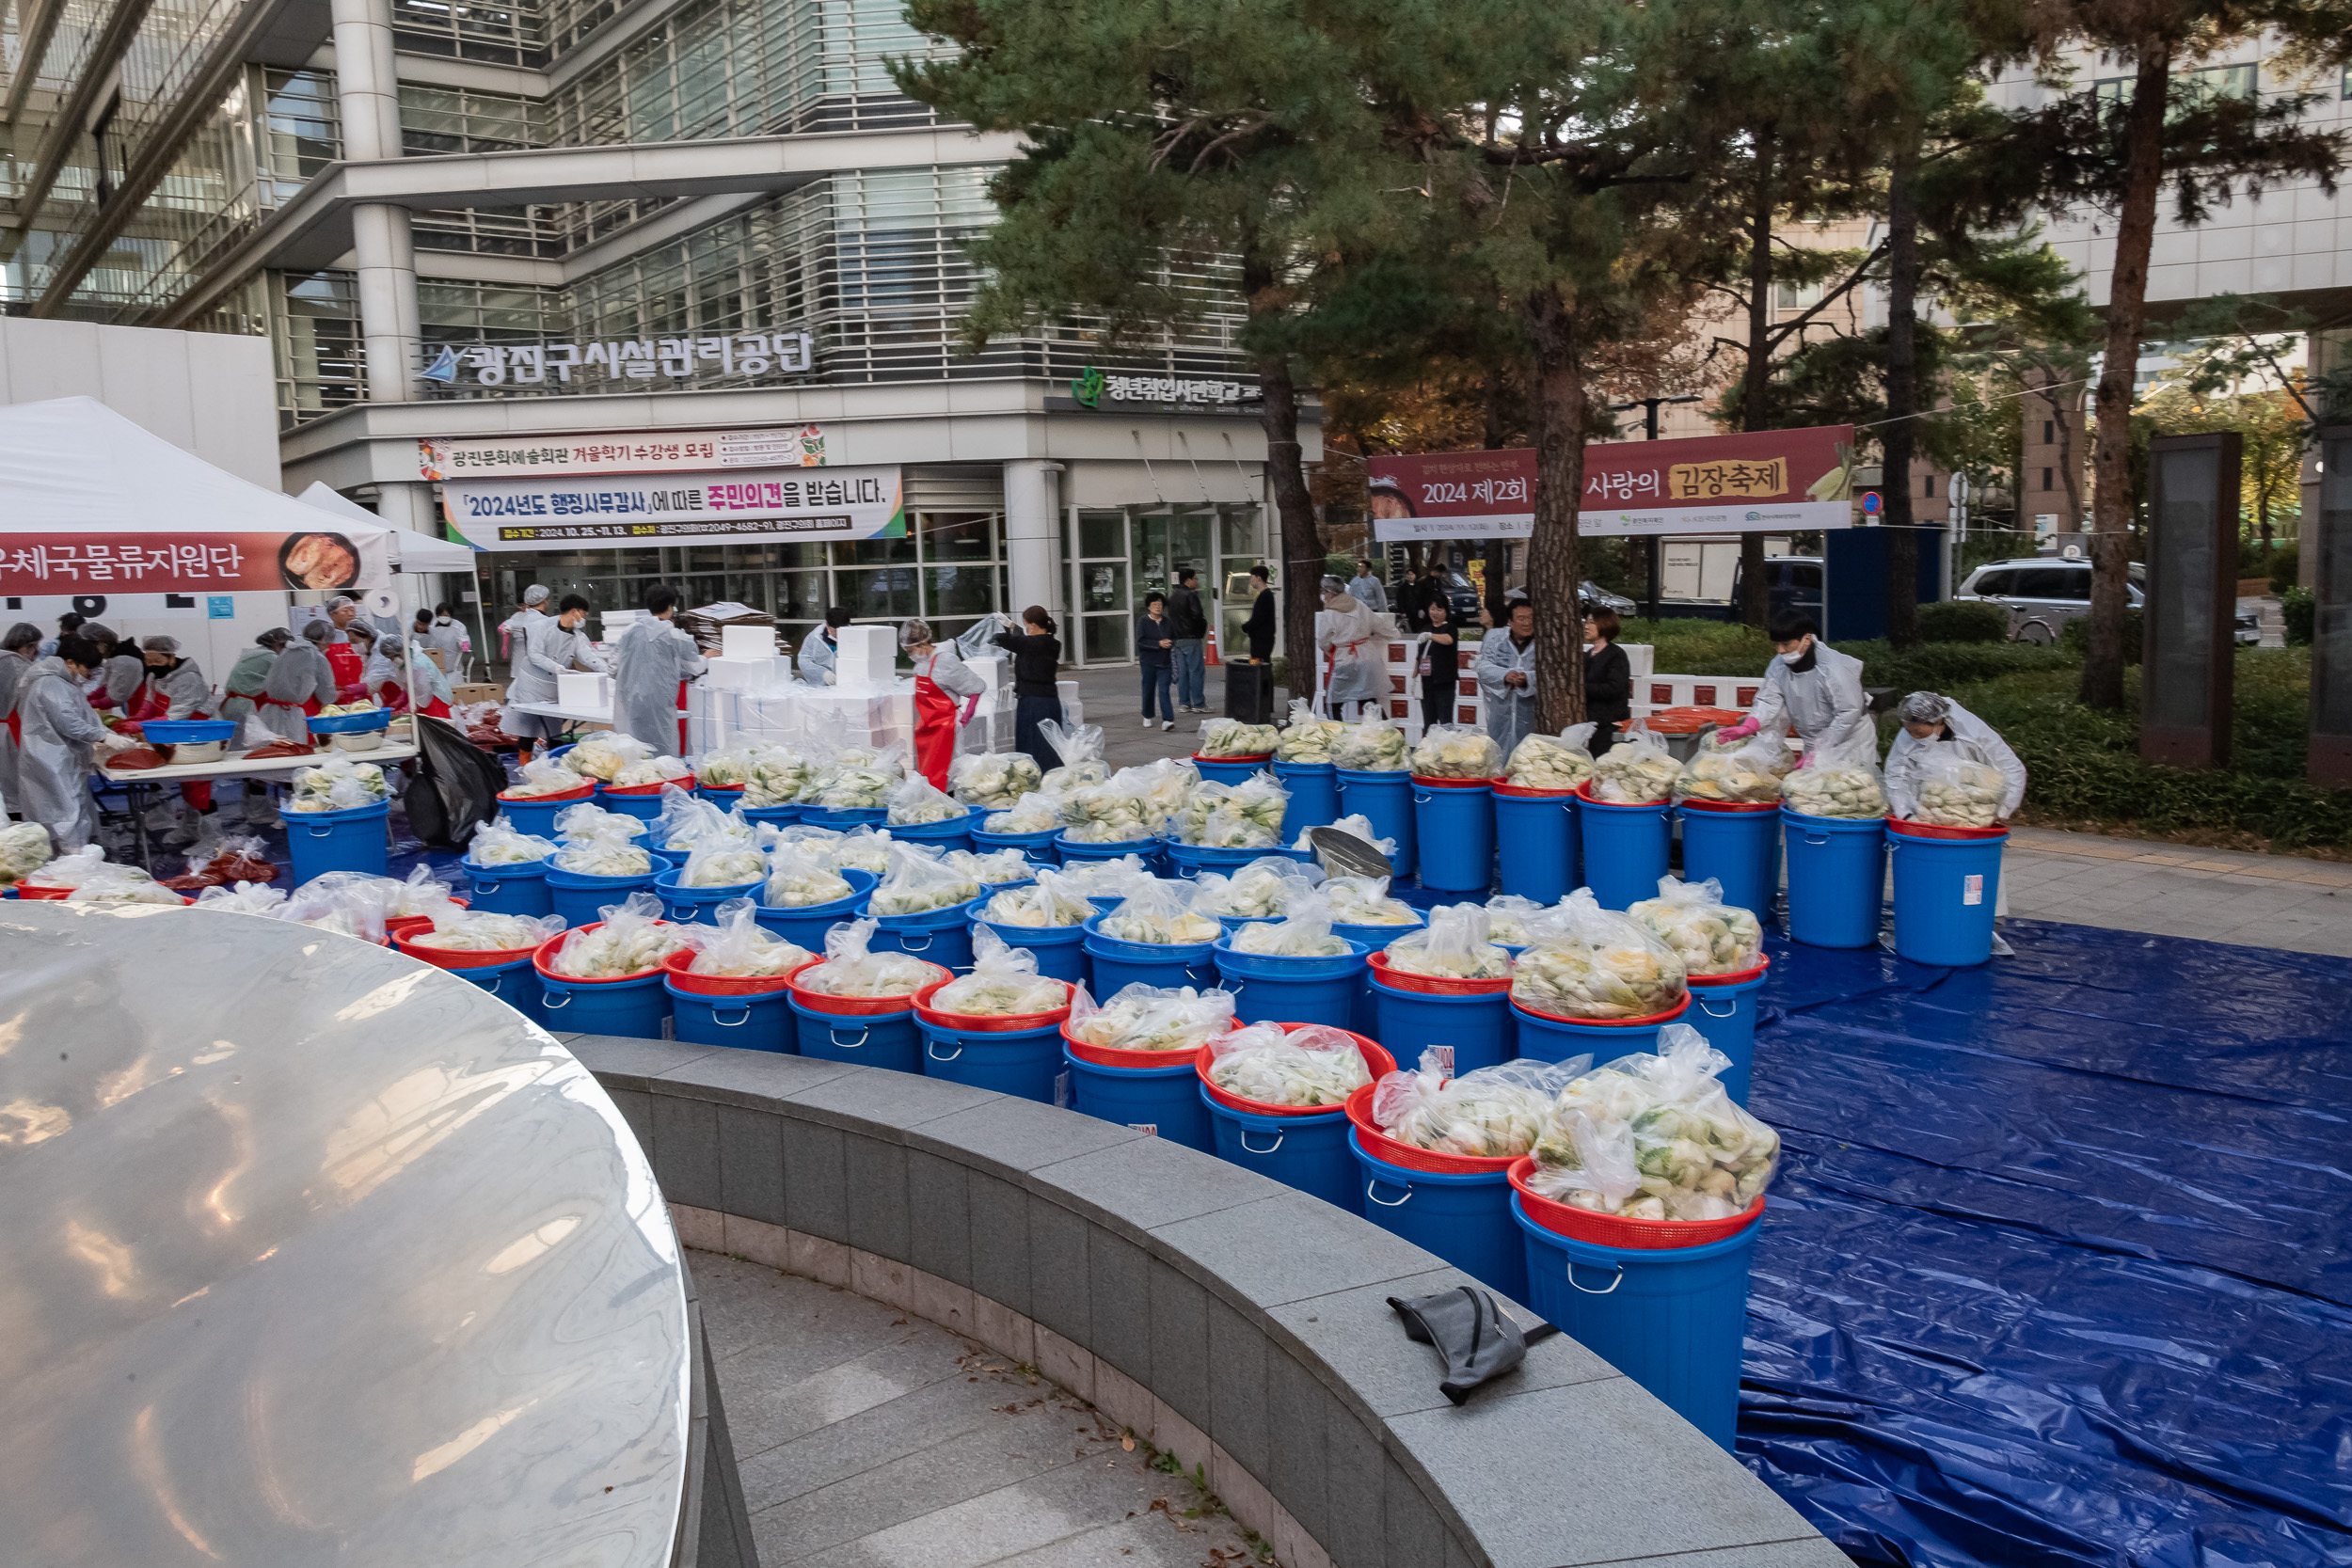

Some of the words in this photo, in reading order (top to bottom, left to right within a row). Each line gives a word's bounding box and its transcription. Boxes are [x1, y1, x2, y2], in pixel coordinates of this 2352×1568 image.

[469, 333, 814, 387] 광진구시설관리공단
[1106, 375, 1239, 404] 청년취업사관학교
[453, 448, 569, 467] 광진문화예술회관
[573, 445, 630, 463] 겨울학기
[634, 444, 679, 460] 수강생
[684, 442, 713, 459] 모집
[673, 489, 703, 510] 따른
[707, 482, 801, 511] 주민의견을
[805, 478, 886, 506] 받습니다.
[1422, 482, 1468, 503] 2024
[1471, 477, 1527, 504] 제2회
[1585, 468, 1661, 499] 사랑의
[1677, 461, 1781, 497] 김장축제
